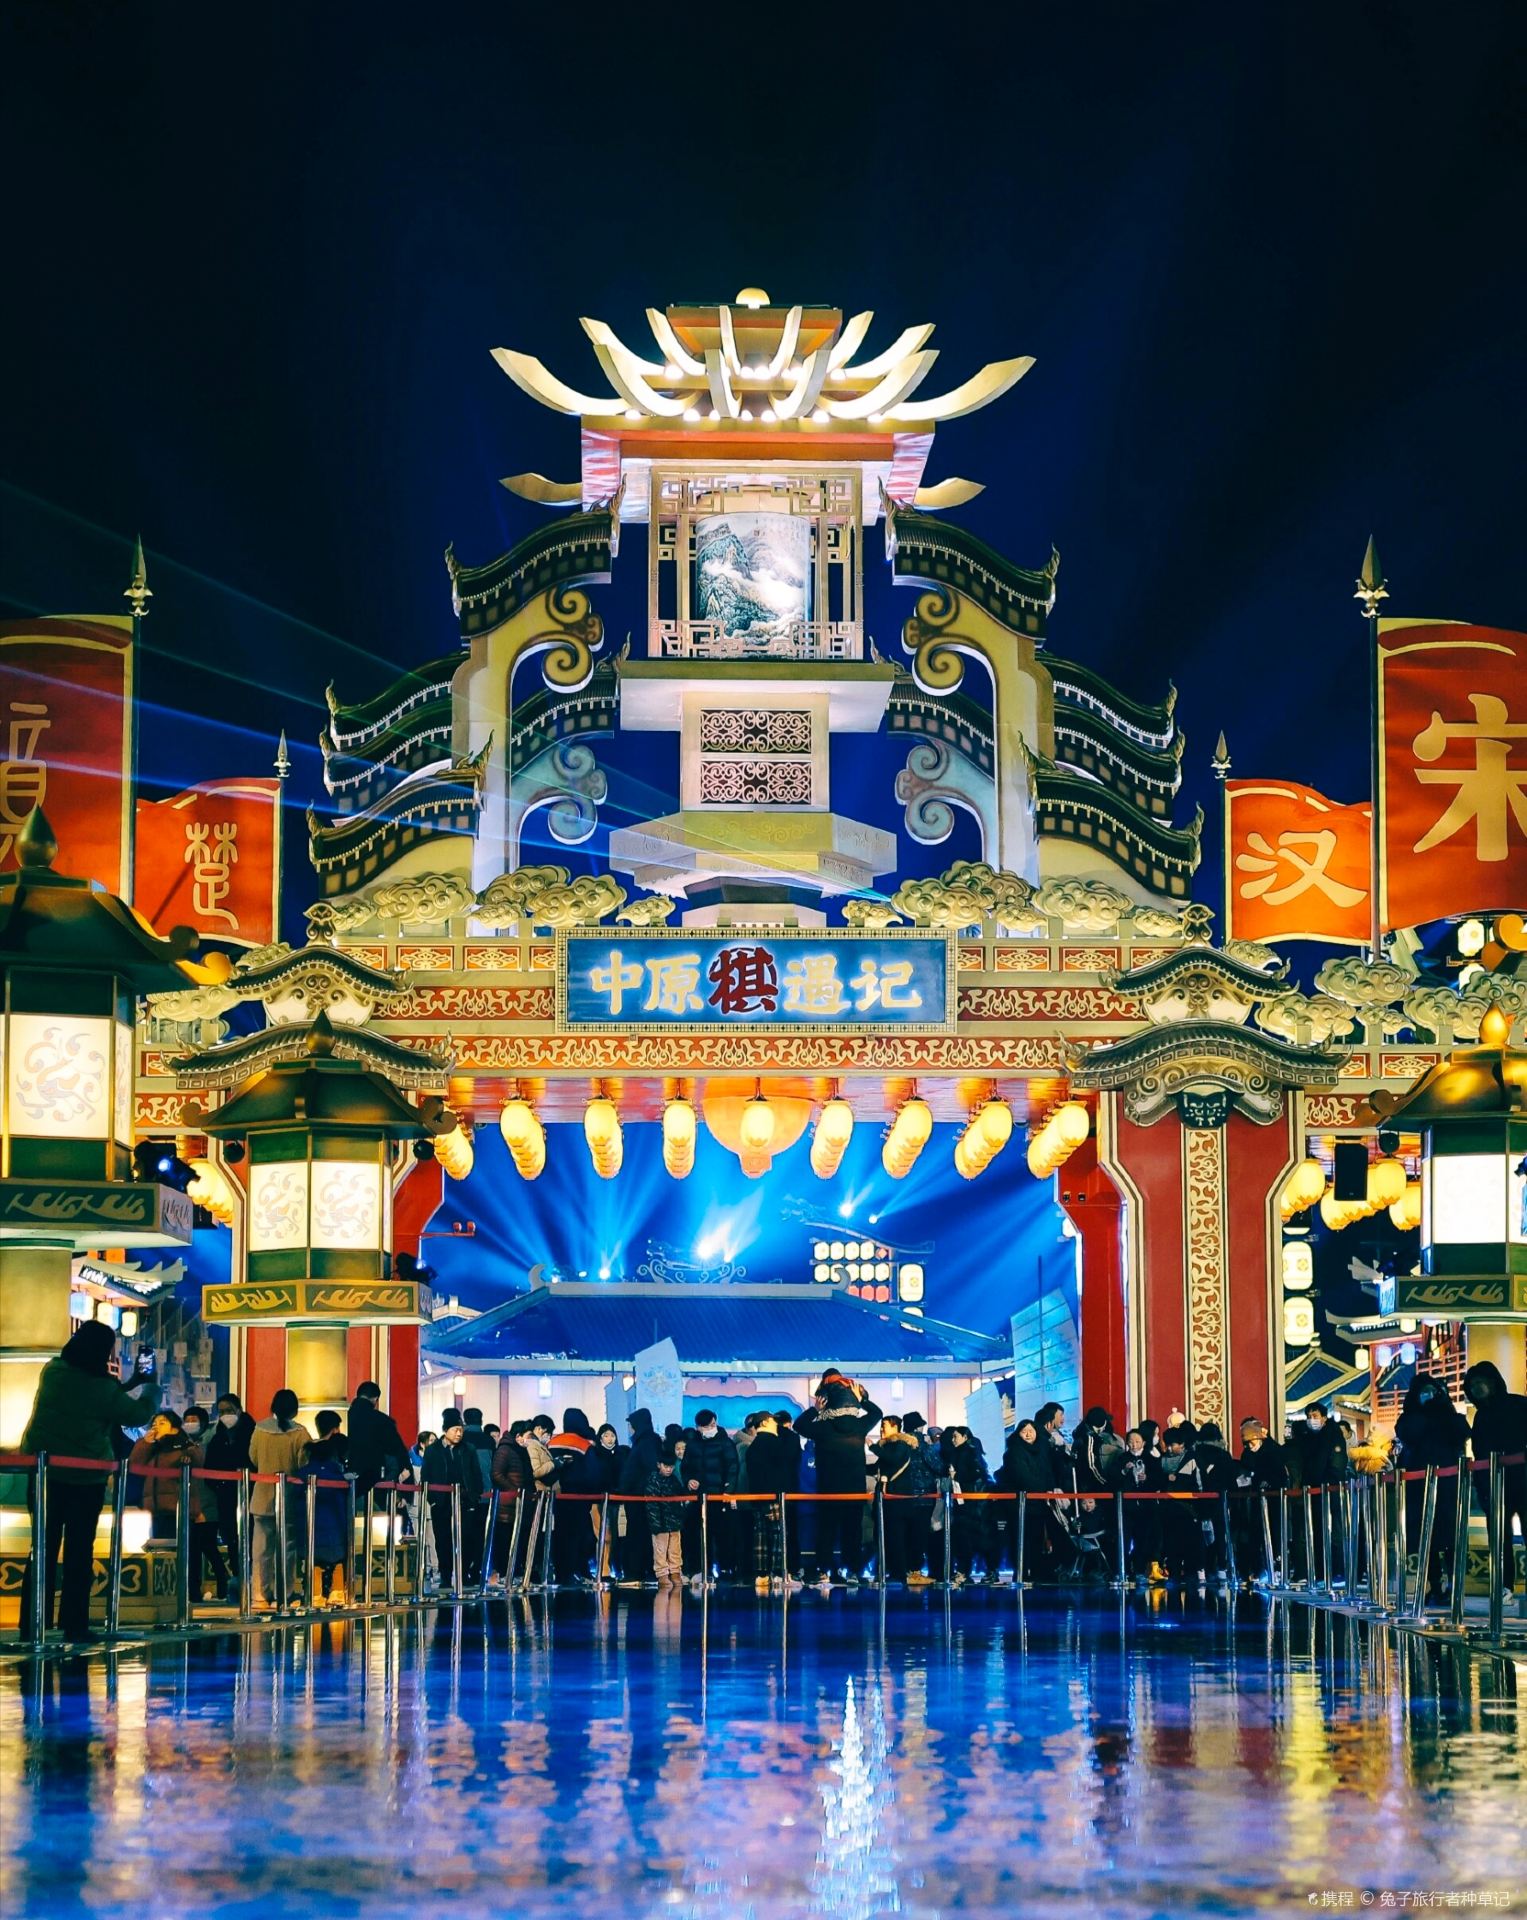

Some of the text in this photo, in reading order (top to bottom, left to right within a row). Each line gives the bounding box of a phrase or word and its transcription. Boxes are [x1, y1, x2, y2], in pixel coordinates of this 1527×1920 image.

[1412, 693, 1527, 862] 宋
[1235, 829, 1368, 908] 汉
[588, 945, 923, 1015] 中原棋遇记
